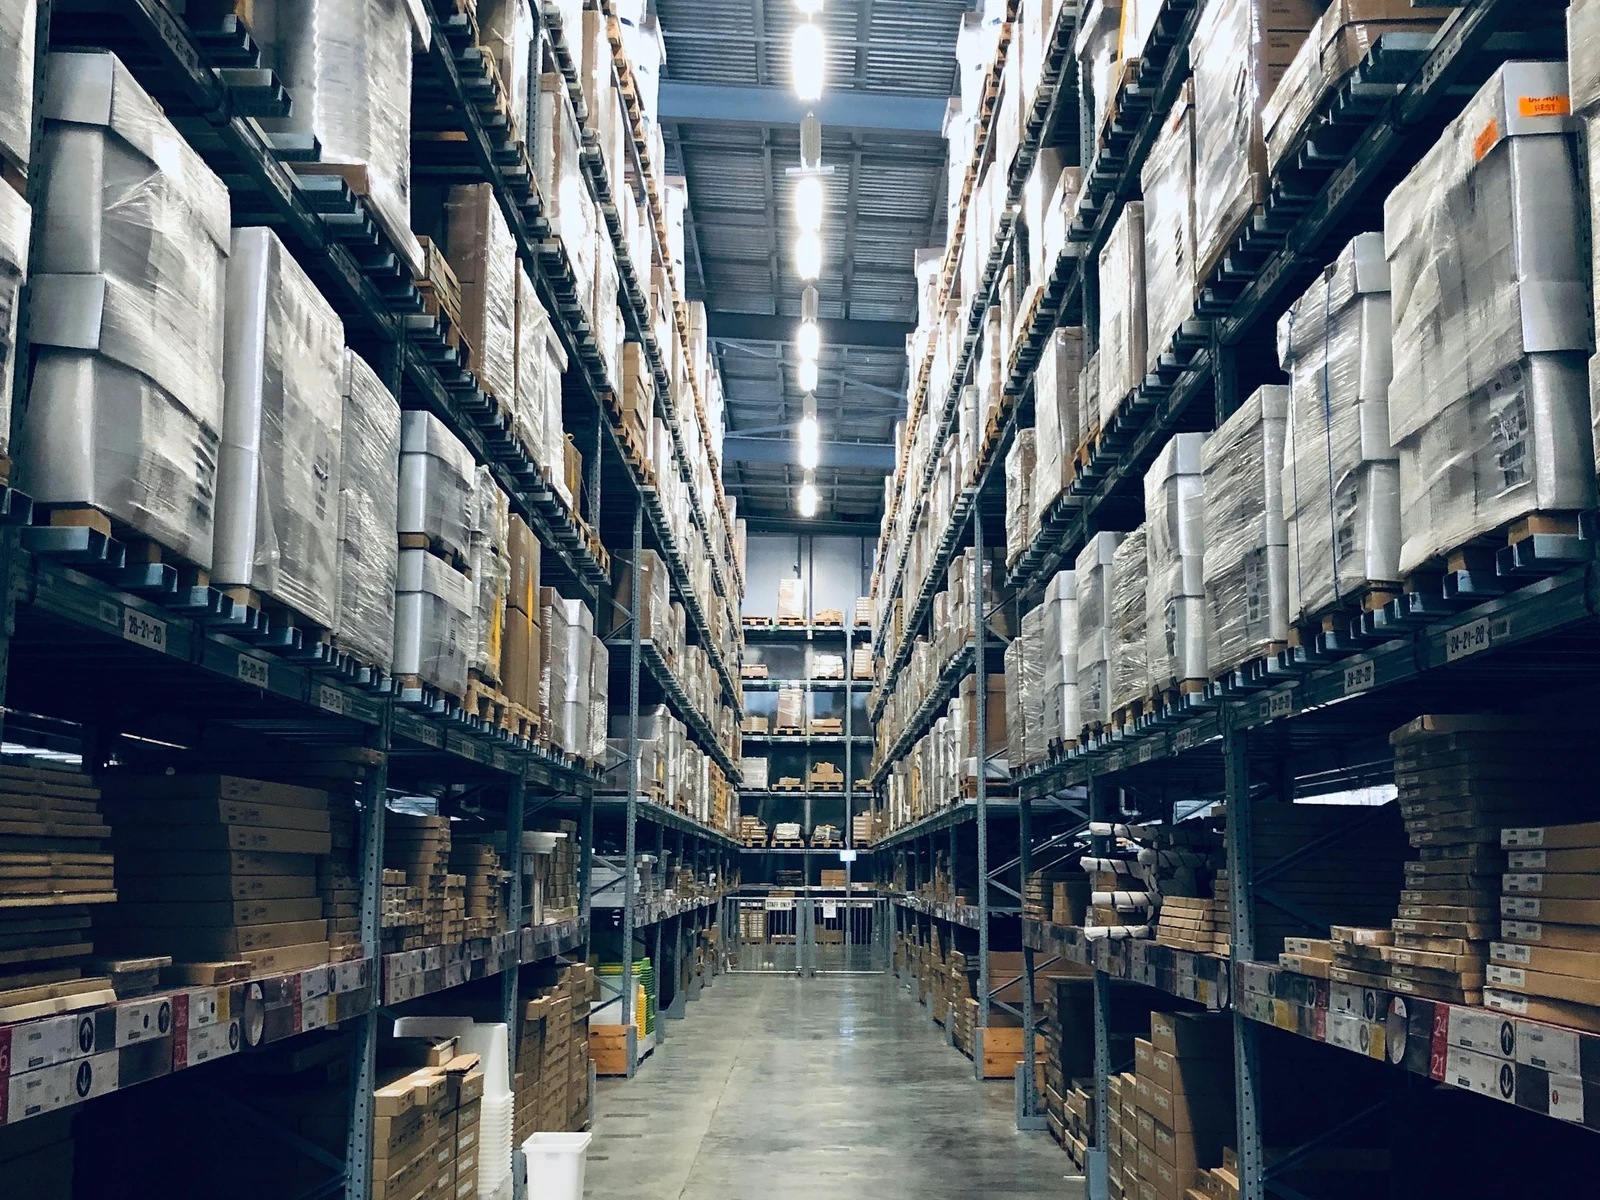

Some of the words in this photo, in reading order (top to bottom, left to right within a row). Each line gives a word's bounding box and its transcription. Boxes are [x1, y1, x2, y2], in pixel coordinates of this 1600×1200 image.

[1451, 624, 1485, 654] 24-21-20
[1434, 1016, 1447, 1037] 24
[1432, 1053, 1444, 1077] 21
